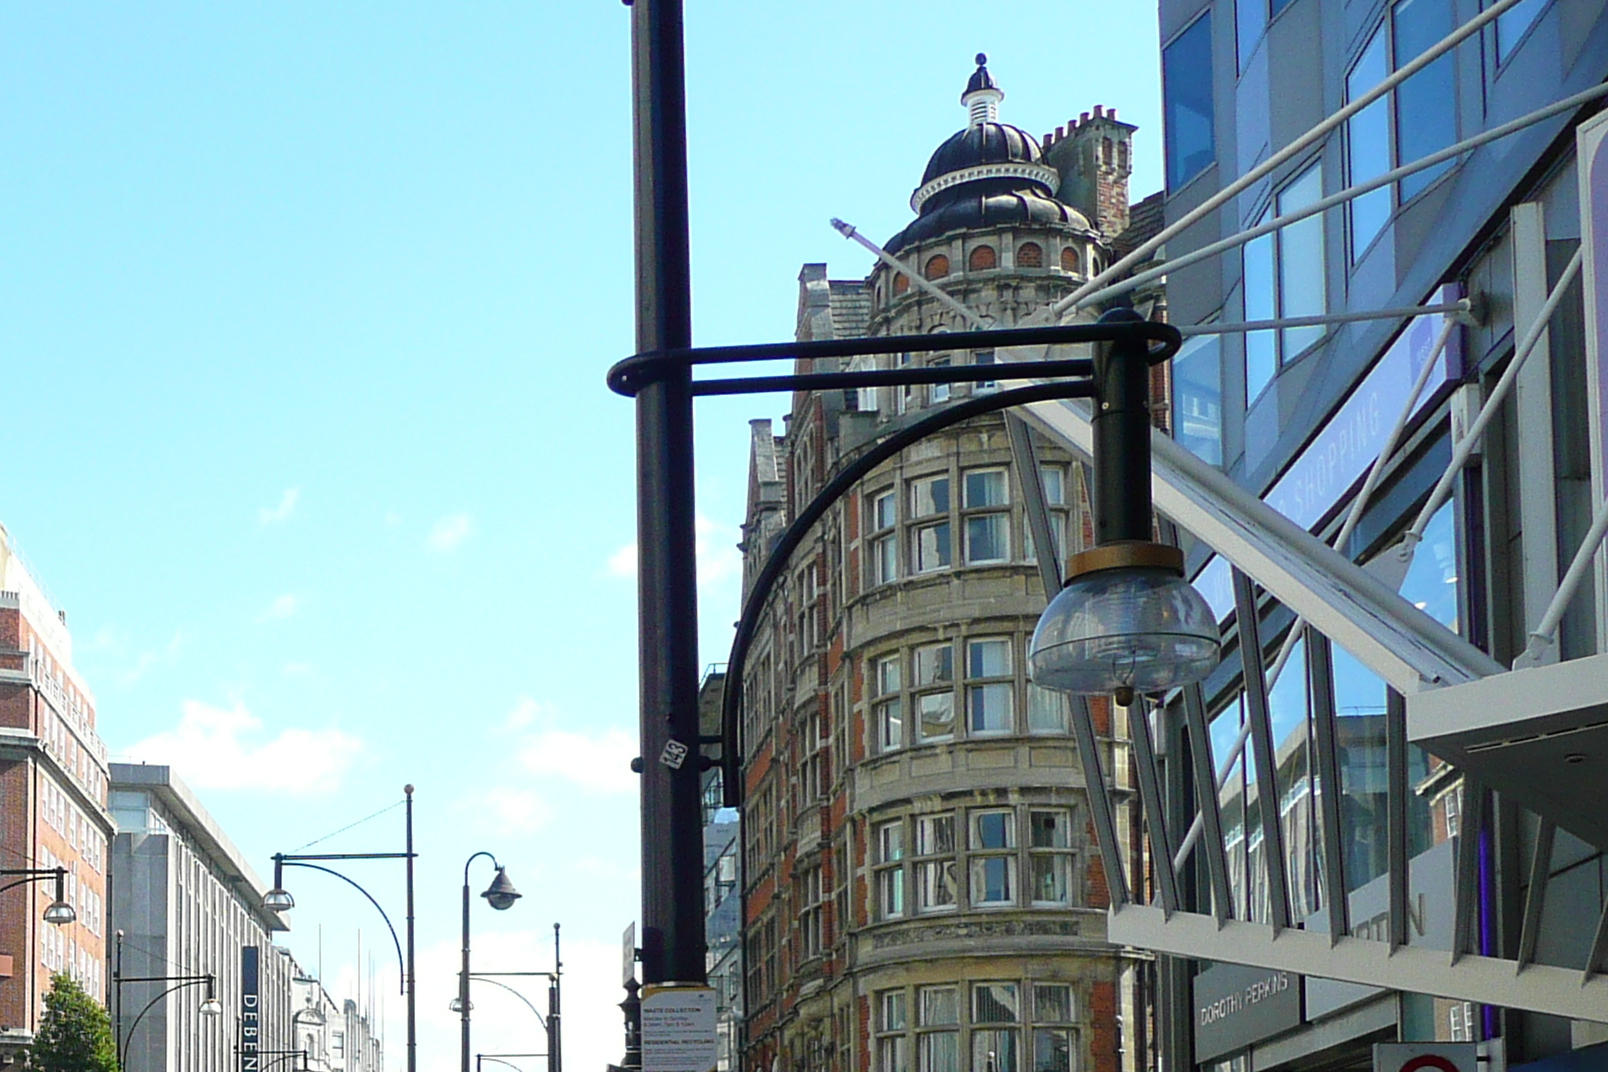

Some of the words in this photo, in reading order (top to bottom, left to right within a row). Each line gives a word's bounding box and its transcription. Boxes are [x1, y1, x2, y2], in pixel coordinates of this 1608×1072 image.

[1294, 391, 1380, 521] SHOPPING
[663, 742, 686, 766] 143
[1201, 993, 1243, 1026] DOROTHY
[1245, 972, 1288, 1004] PERKINS
